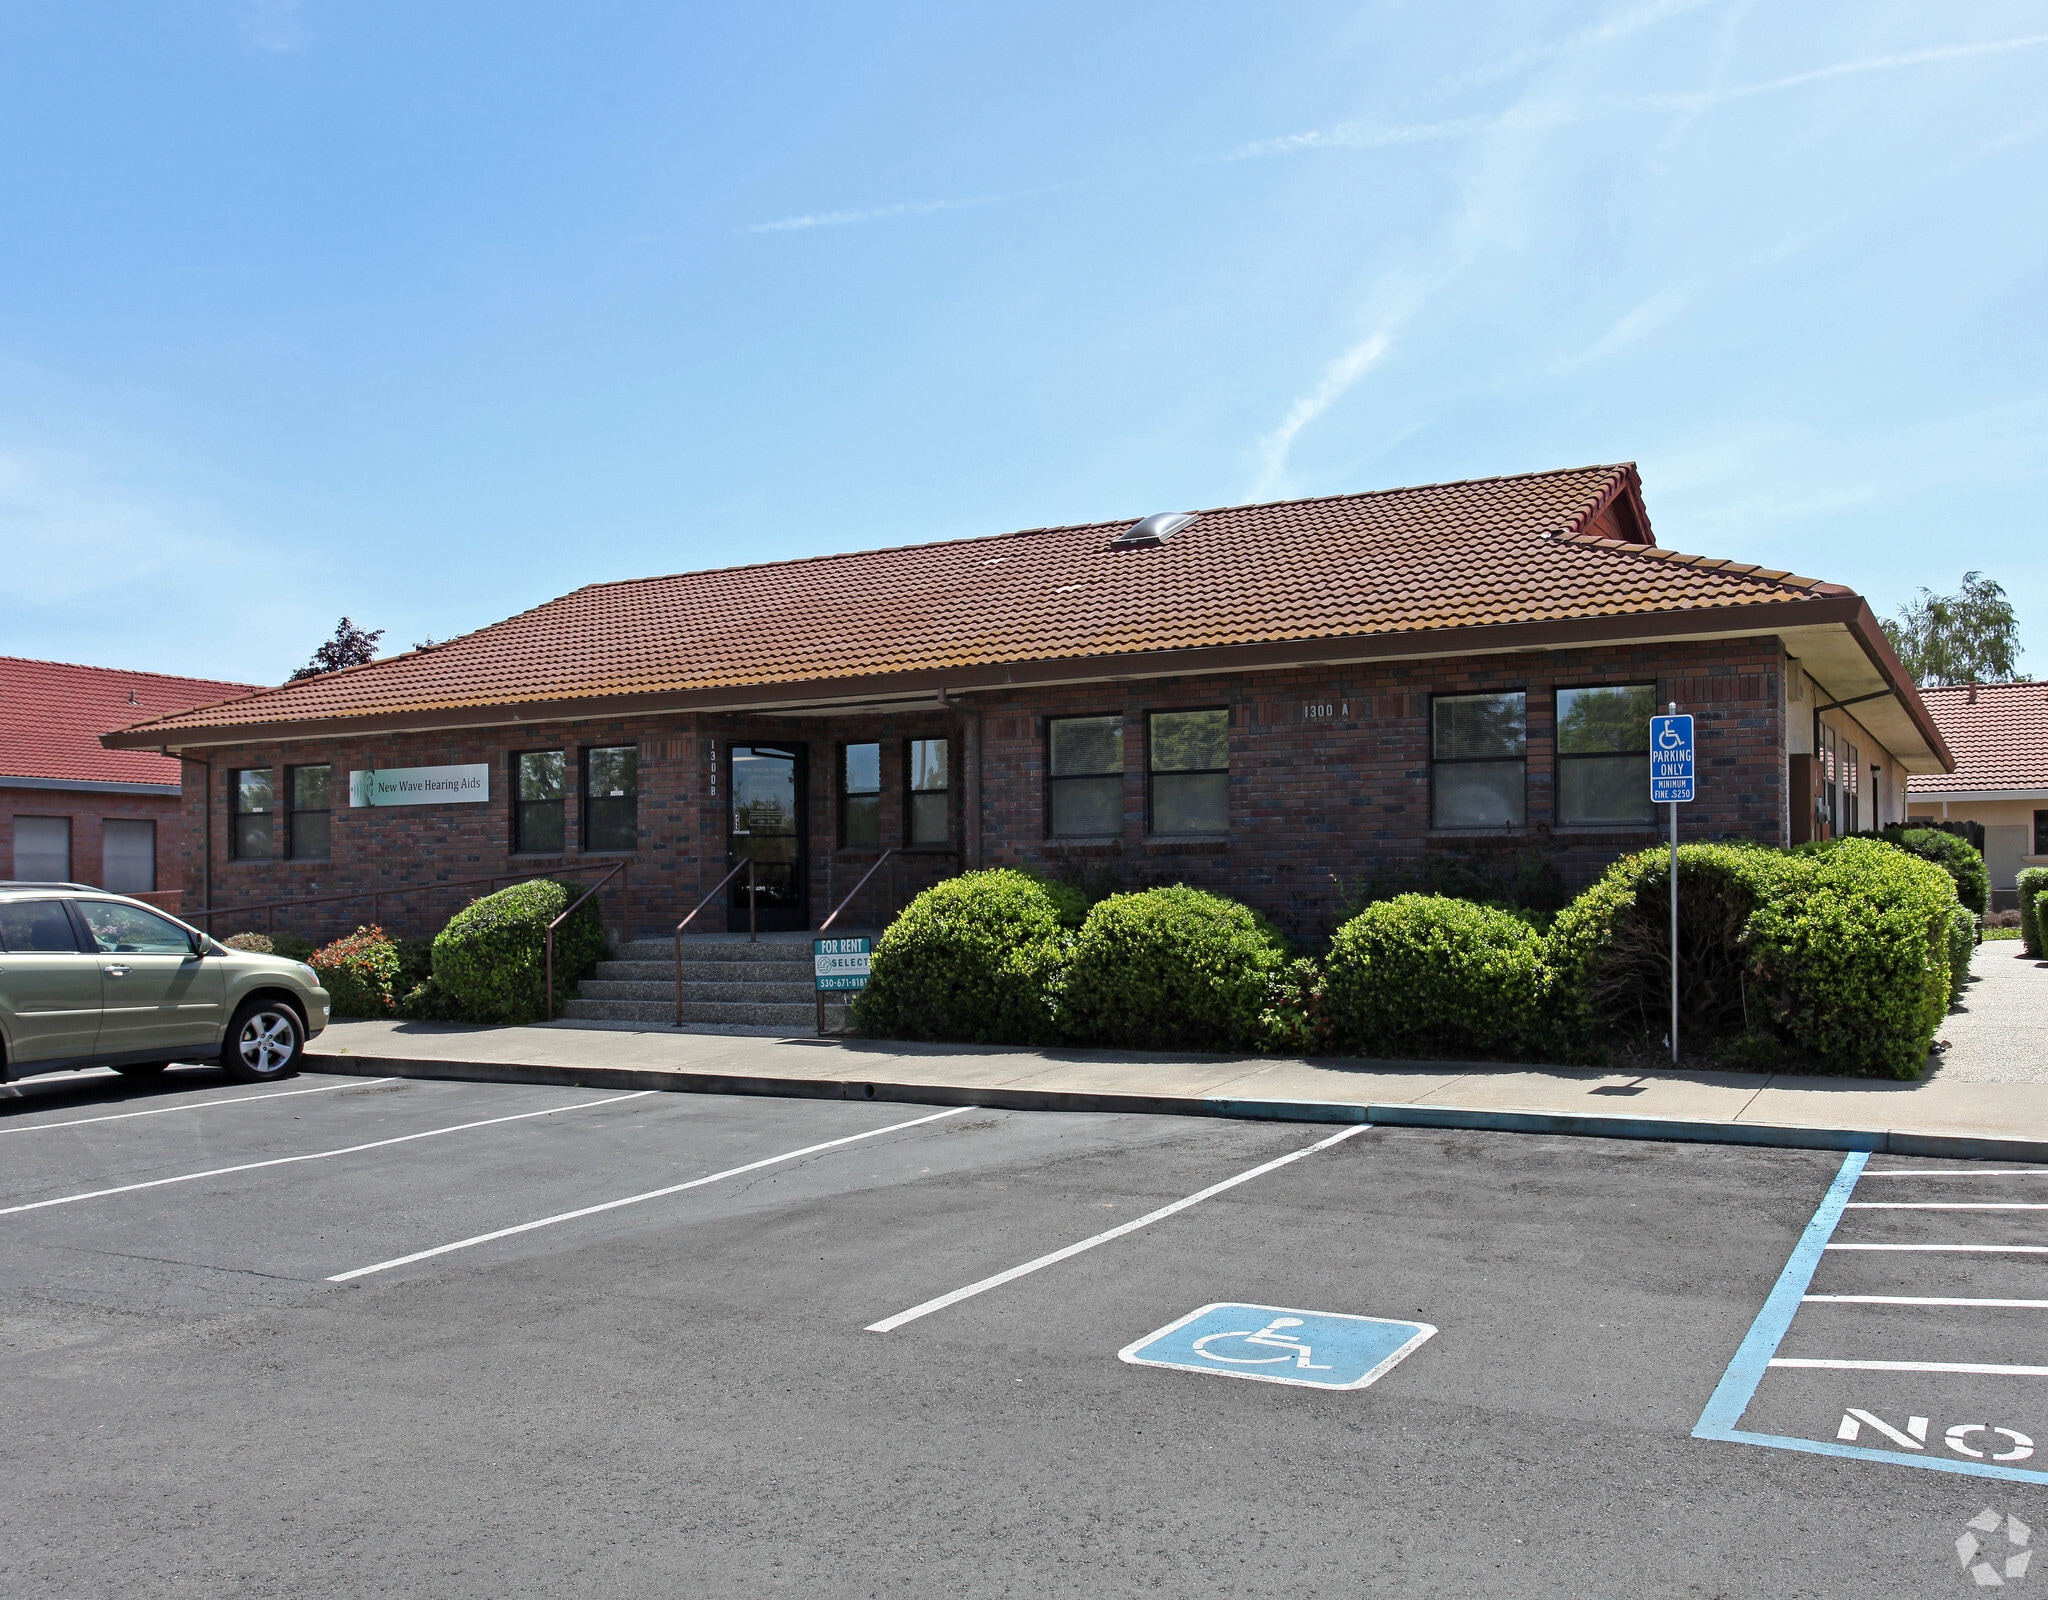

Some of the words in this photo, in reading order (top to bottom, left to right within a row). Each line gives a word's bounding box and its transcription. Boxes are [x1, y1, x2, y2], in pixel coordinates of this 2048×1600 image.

[1305, 704, 1333, 718] 1300
[1342, 703, 1349, 715] A
[1653, 749, 1691, 763] PARKING
[1661, 763, 1684, 776] ONLY
[378, 782, 397, 793] New
[399, 780, 423, 791] Wave
[424, 779, 459, 792] Hearing
[460, 778, 481, 789] Aids
[1658, 780, 1687, 789] MINIMUM
[1654, 790, 1669, 799] FINE
[1671, 789, 1691, 798] $250
[821, 940, 838, 954] FOR
[840, 938, 862, 953] RENT
[831, 957, 869, 967] SELECT
[1836, 1407, 2034, 1460] NO
